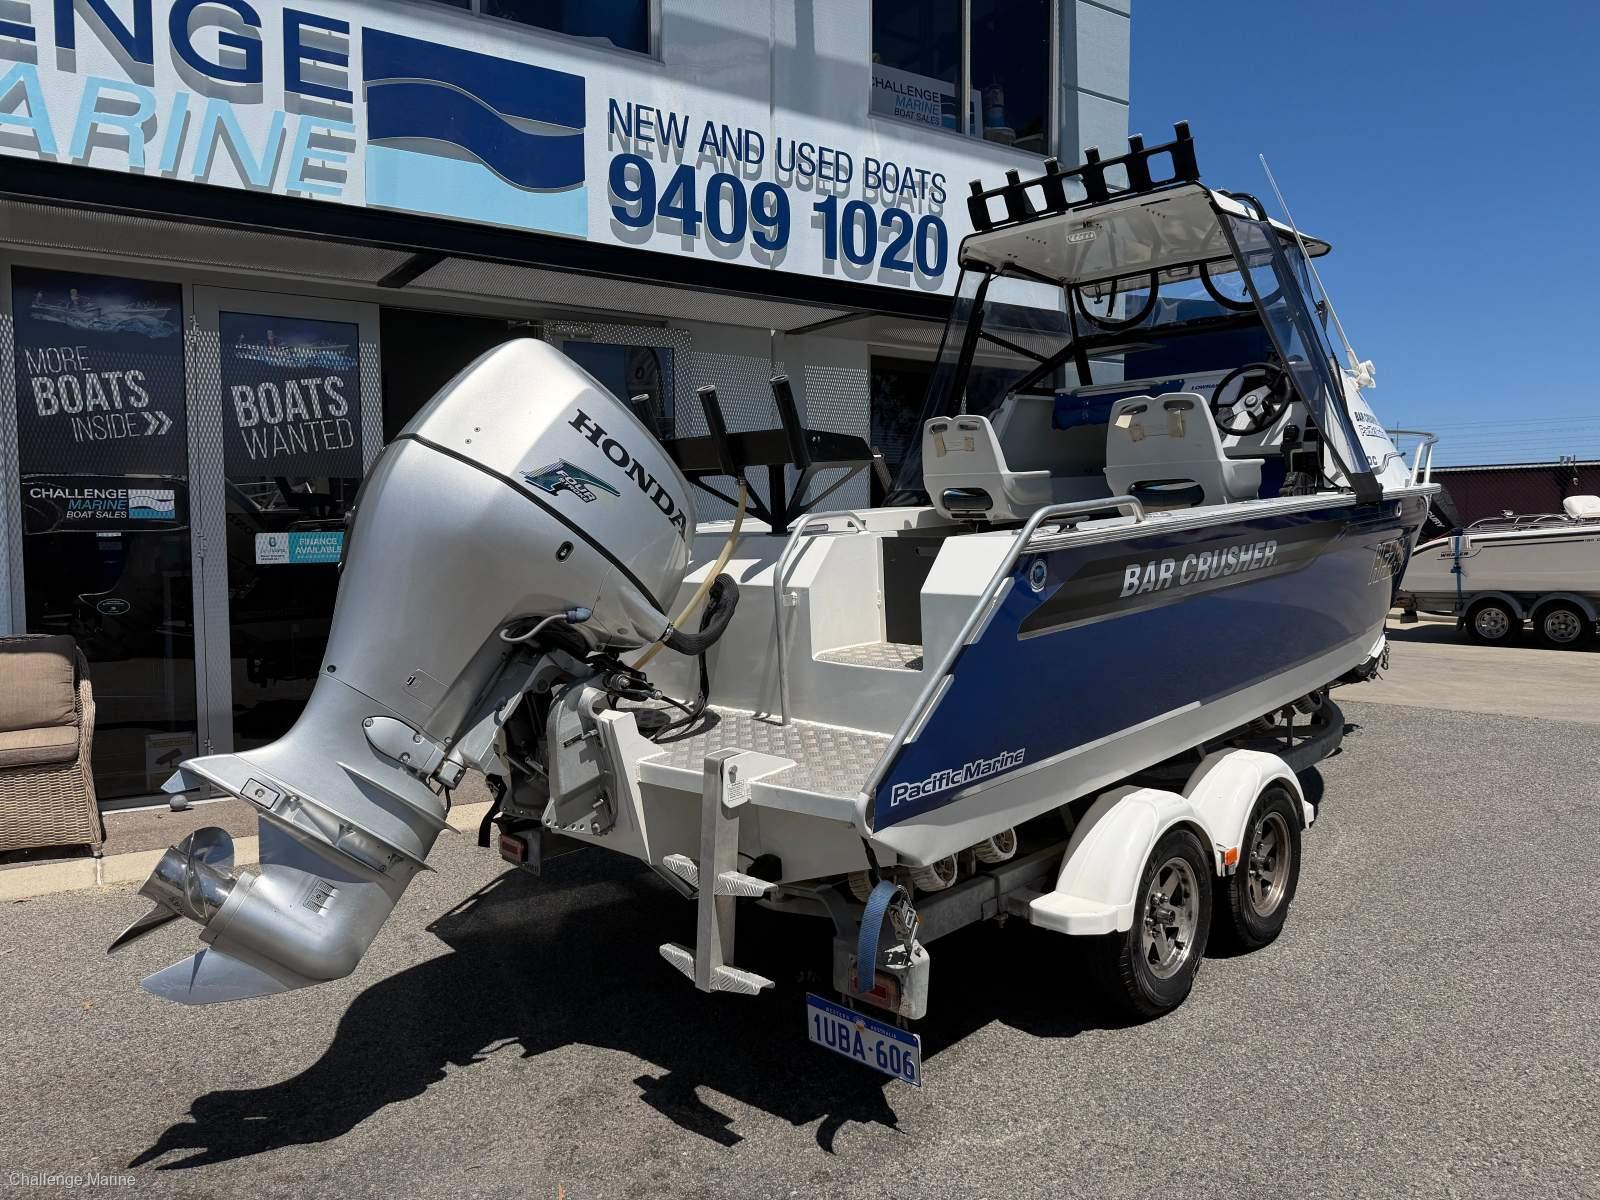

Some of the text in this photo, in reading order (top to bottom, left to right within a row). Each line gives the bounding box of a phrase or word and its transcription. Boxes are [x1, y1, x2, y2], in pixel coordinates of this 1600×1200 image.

[894, 108, 940, 126] BOAT SALES
[895, 95, 940, 115] MARINE
[608, 98, 947, 204] NEW AND USED BOATS
[608, 153, 948, 277] 9409 1020
[24, 346, 92, 375] MORE
[31, 369, 149, 416] BOATS
[230, 375, 349, 428] BOATS
[71, 411, 140, 442] INSIDE
[241, 418, 355, 460] WANTED
[30, 488, 127, 499] CHALLENGE
[556, 470, 597, 500] FOUR
[568, 409, 687, 543] HONDA
[66, 511, 127, 519] BOAT SALES
[68, 499, 126, 510] MARINE
[295, 546, 342, 554] AVAILABLE
[1120, 540, 1278, 598] BAR CRUSHER
[890, 748, 1026, 807] Pacific Marine
[814, 1013, 915, 1081] 1UBA-606
